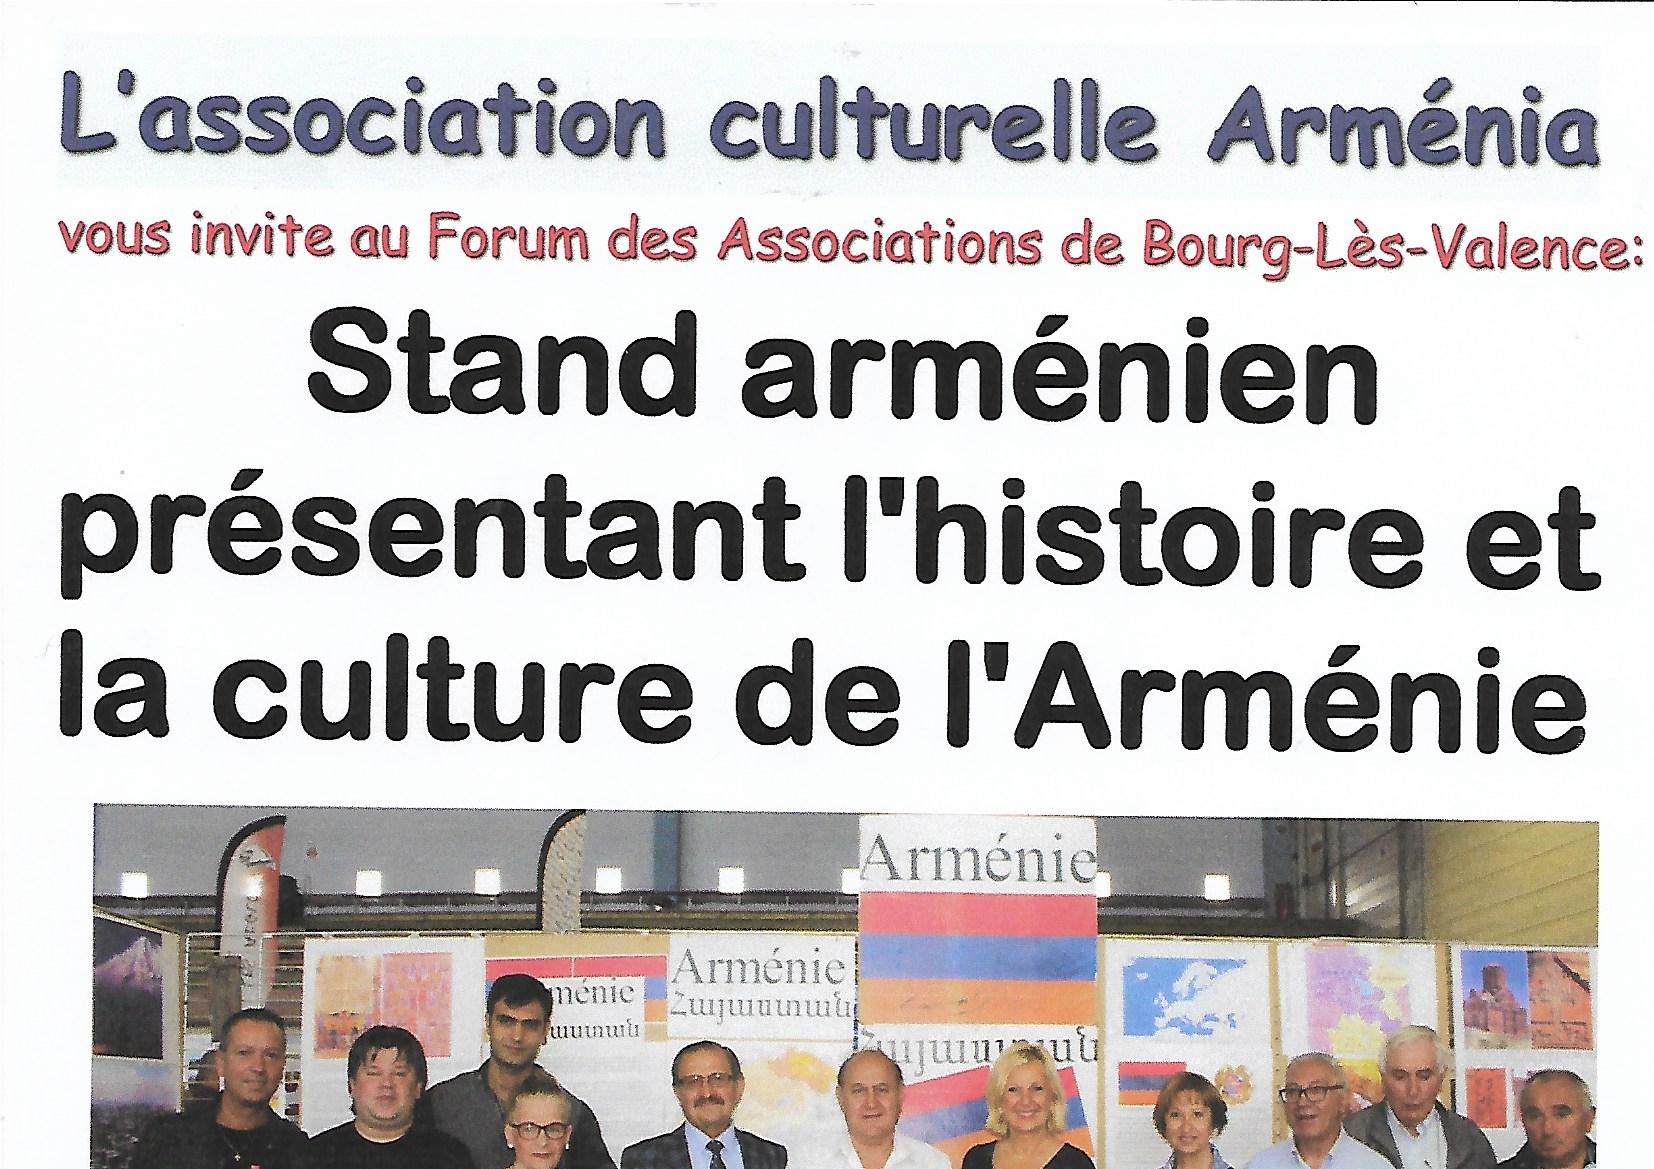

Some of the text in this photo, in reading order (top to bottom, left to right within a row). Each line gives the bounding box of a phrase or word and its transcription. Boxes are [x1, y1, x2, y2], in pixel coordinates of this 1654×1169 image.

[61, 69, 1601, 169] L'association culturelle Arménia
[58, 210, 1643, 282] vous invite au Forum des Associations de Bourg-Lès-Valence:
[308, 306, 1377, 425] Stand arménien
[61, 468, 1601, 600] présentant l'histoire et
[60, 629, 1587, 755] la culture de l'Arménie
[860, 832, 1098, 884] Arménie
[549, 978, 635, 1004] ménie
[670, 947, 846, 986] Arménie
